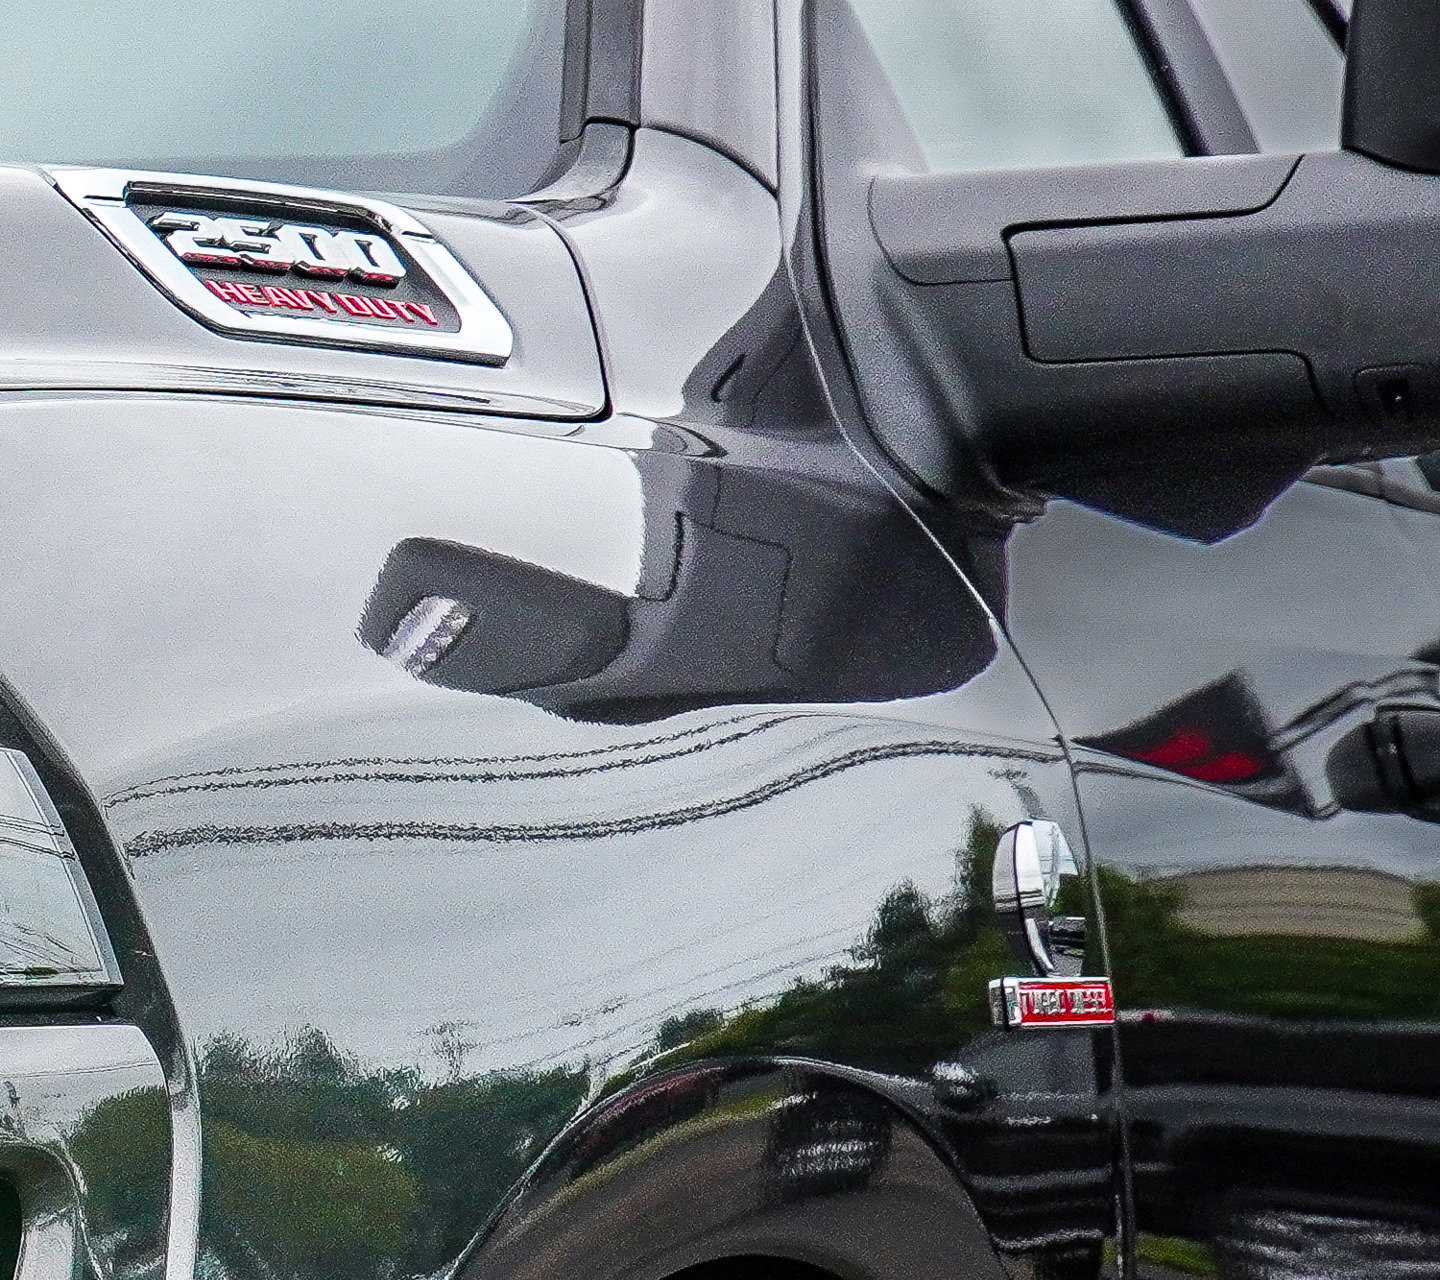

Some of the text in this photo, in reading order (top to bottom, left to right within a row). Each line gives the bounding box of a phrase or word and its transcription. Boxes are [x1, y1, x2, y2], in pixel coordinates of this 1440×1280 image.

[150, 212, 407, 288] 2500
[204, 279, 439, 326] HEAVY DUTY
